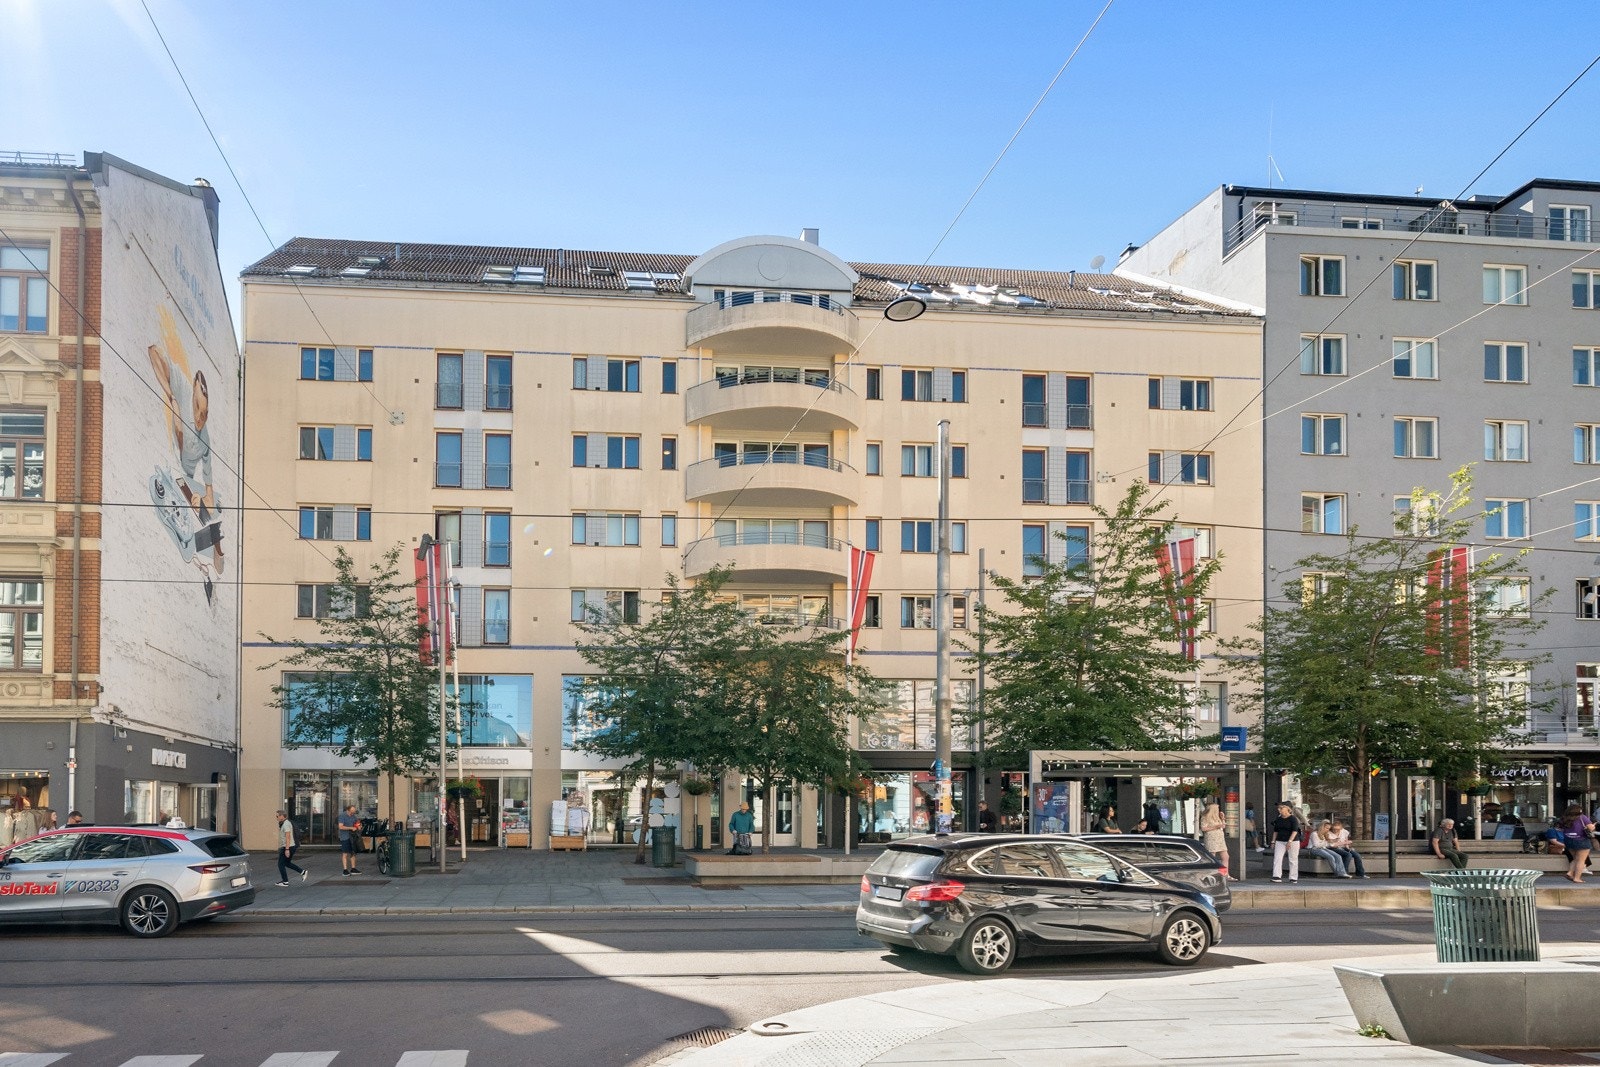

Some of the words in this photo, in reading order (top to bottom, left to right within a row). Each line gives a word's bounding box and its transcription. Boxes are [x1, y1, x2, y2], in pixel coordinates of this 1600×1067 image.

[151, 748, 187, 769] MATCH
[0, 881, 58, 896] sloTaxi
[78, 880, 120, 893] 02323
